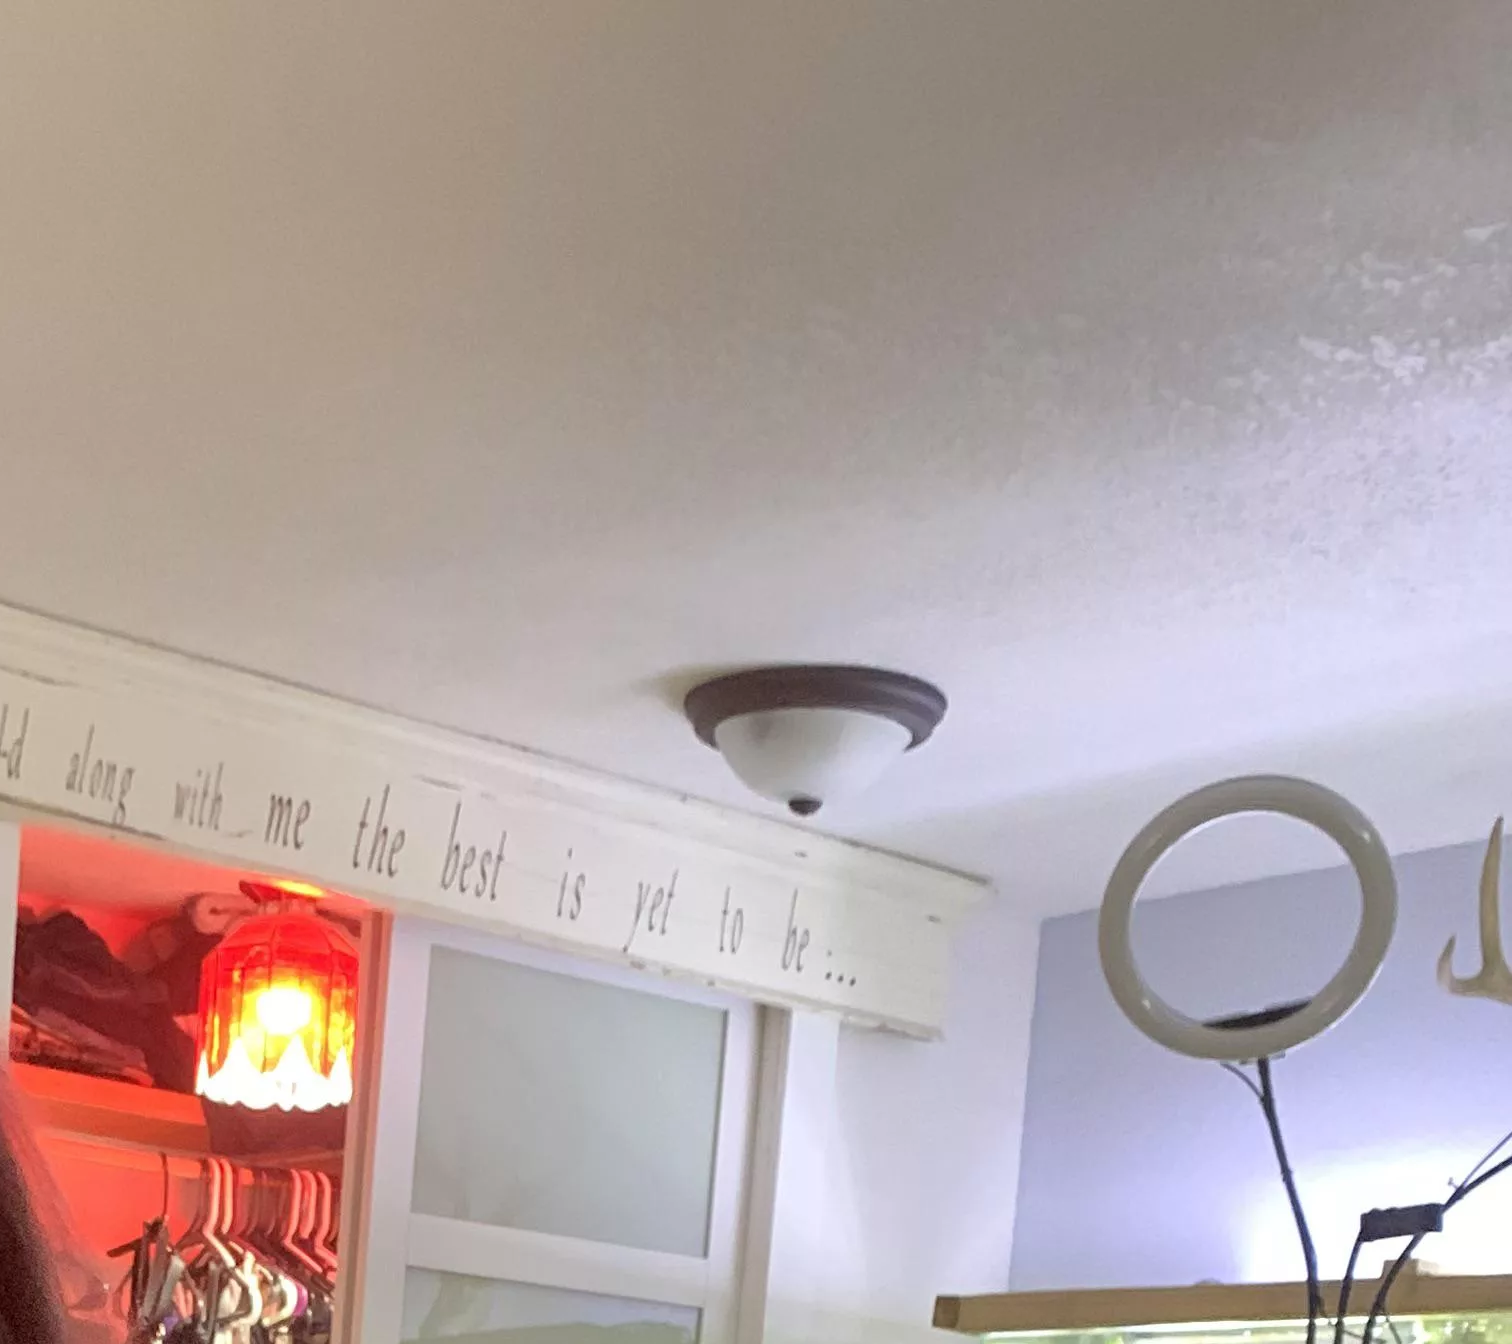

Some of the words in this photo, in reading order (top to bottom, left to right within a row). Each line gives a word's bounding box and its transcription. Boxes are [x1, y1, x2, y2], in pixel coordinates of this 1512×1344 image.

[64, 722, 136, 826] along
[173, 761, 224, 831] with
[263, 793, 312, 851] me
[351, 783, 407, 878] the
[439, 799, 508, 902] best
[556, 846, 587, 921] is
[622, 868, 680, 954] yet
[718, 885, 745, 955] to
